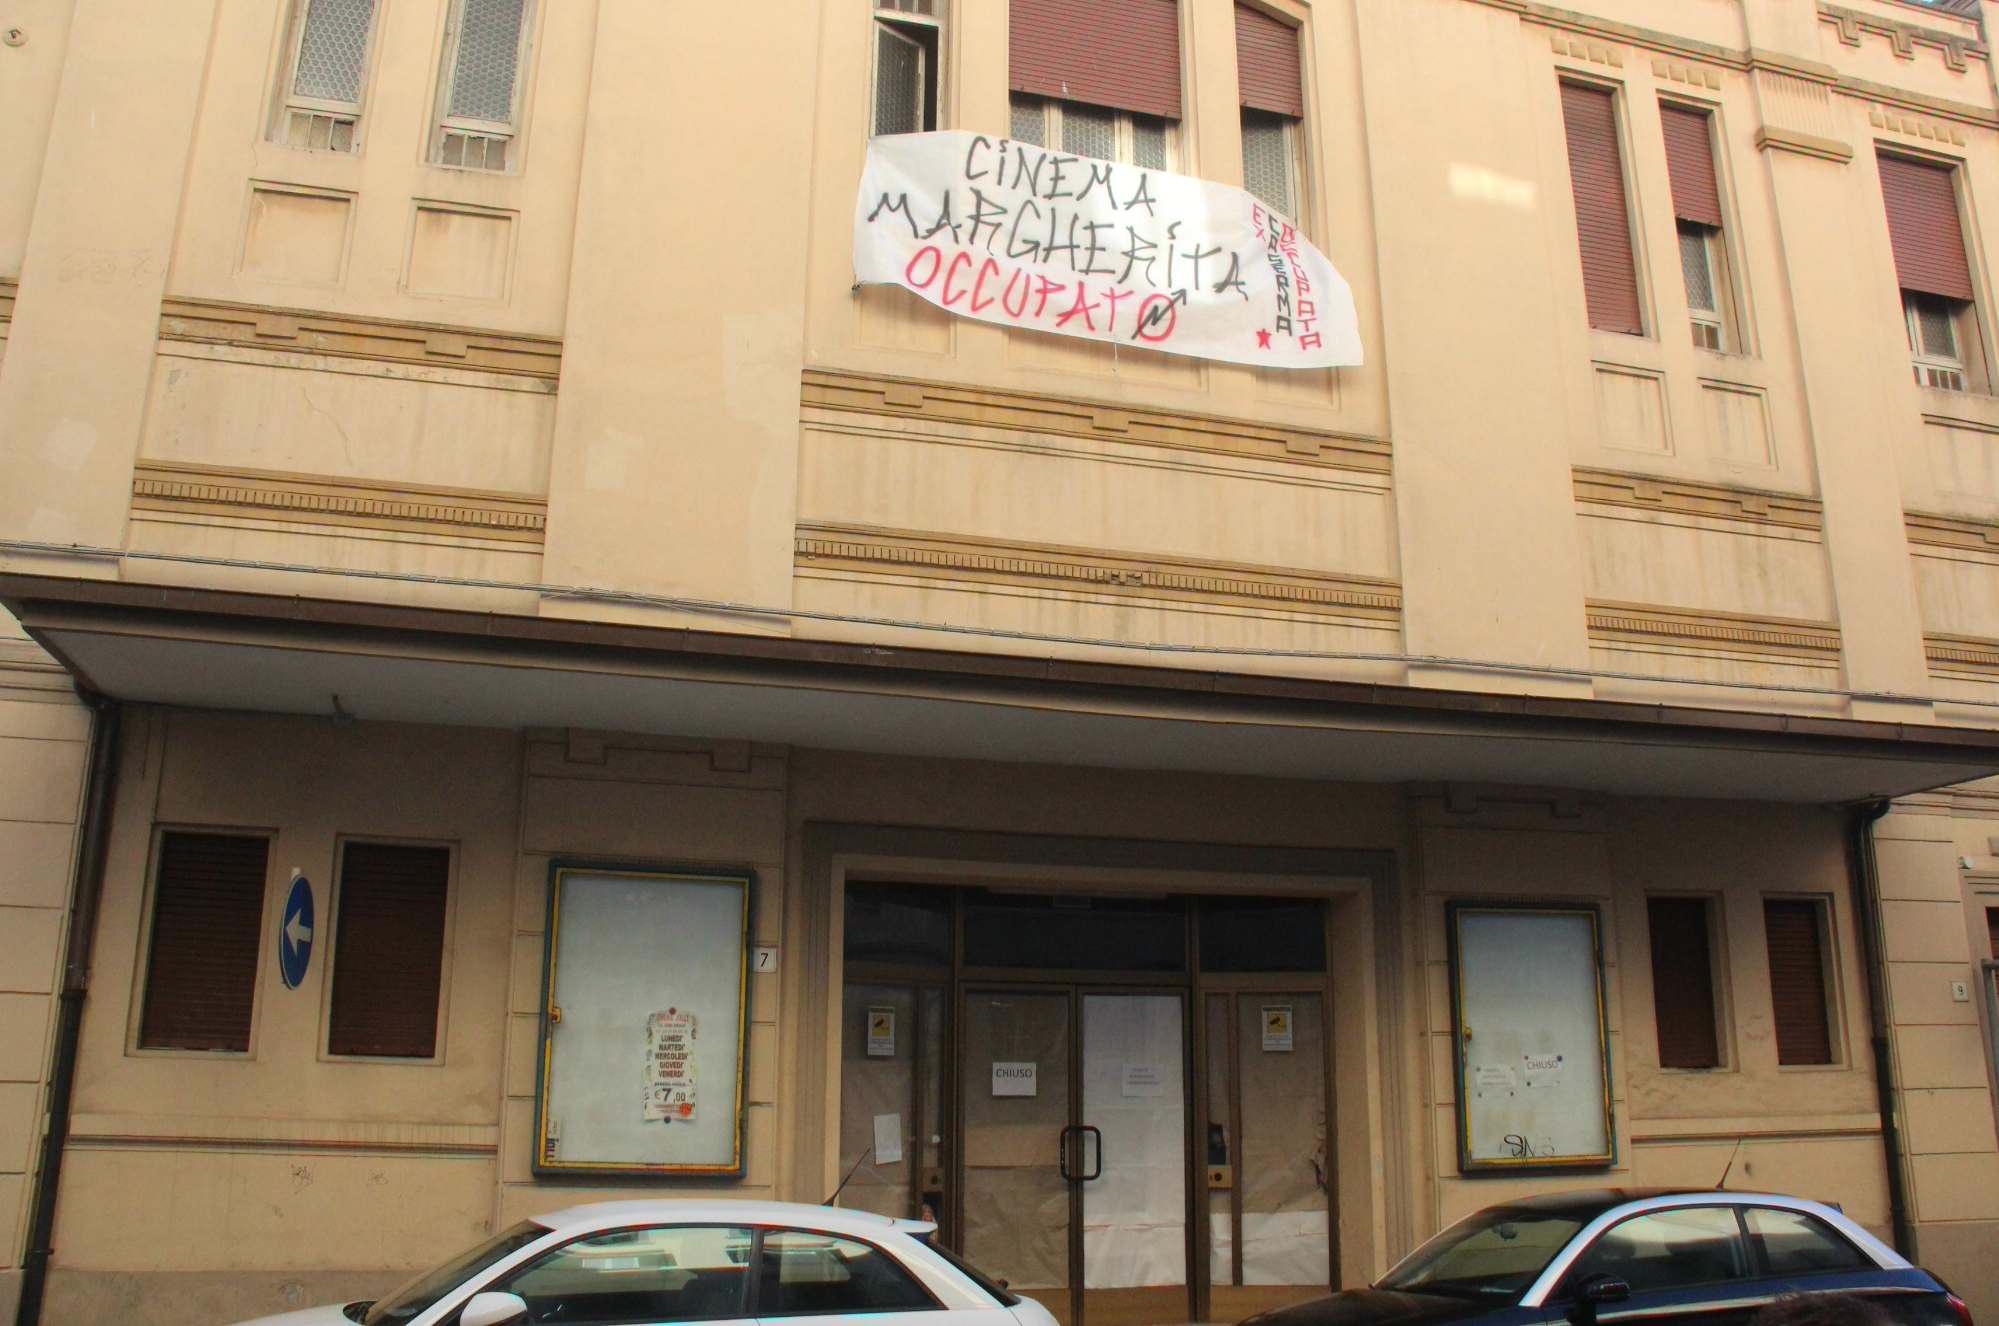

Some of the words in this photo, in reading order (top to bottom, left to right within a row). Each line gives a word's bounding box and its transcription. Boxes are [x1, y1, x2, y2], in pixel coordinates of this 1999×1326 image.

[1252, 203, 1267, 242] EX
[760, 952, 769, 967] 7
[1526, 1060, 1558, 1070] CHIUSO
[995, 1068, 1033, 1079] CHIUSO
